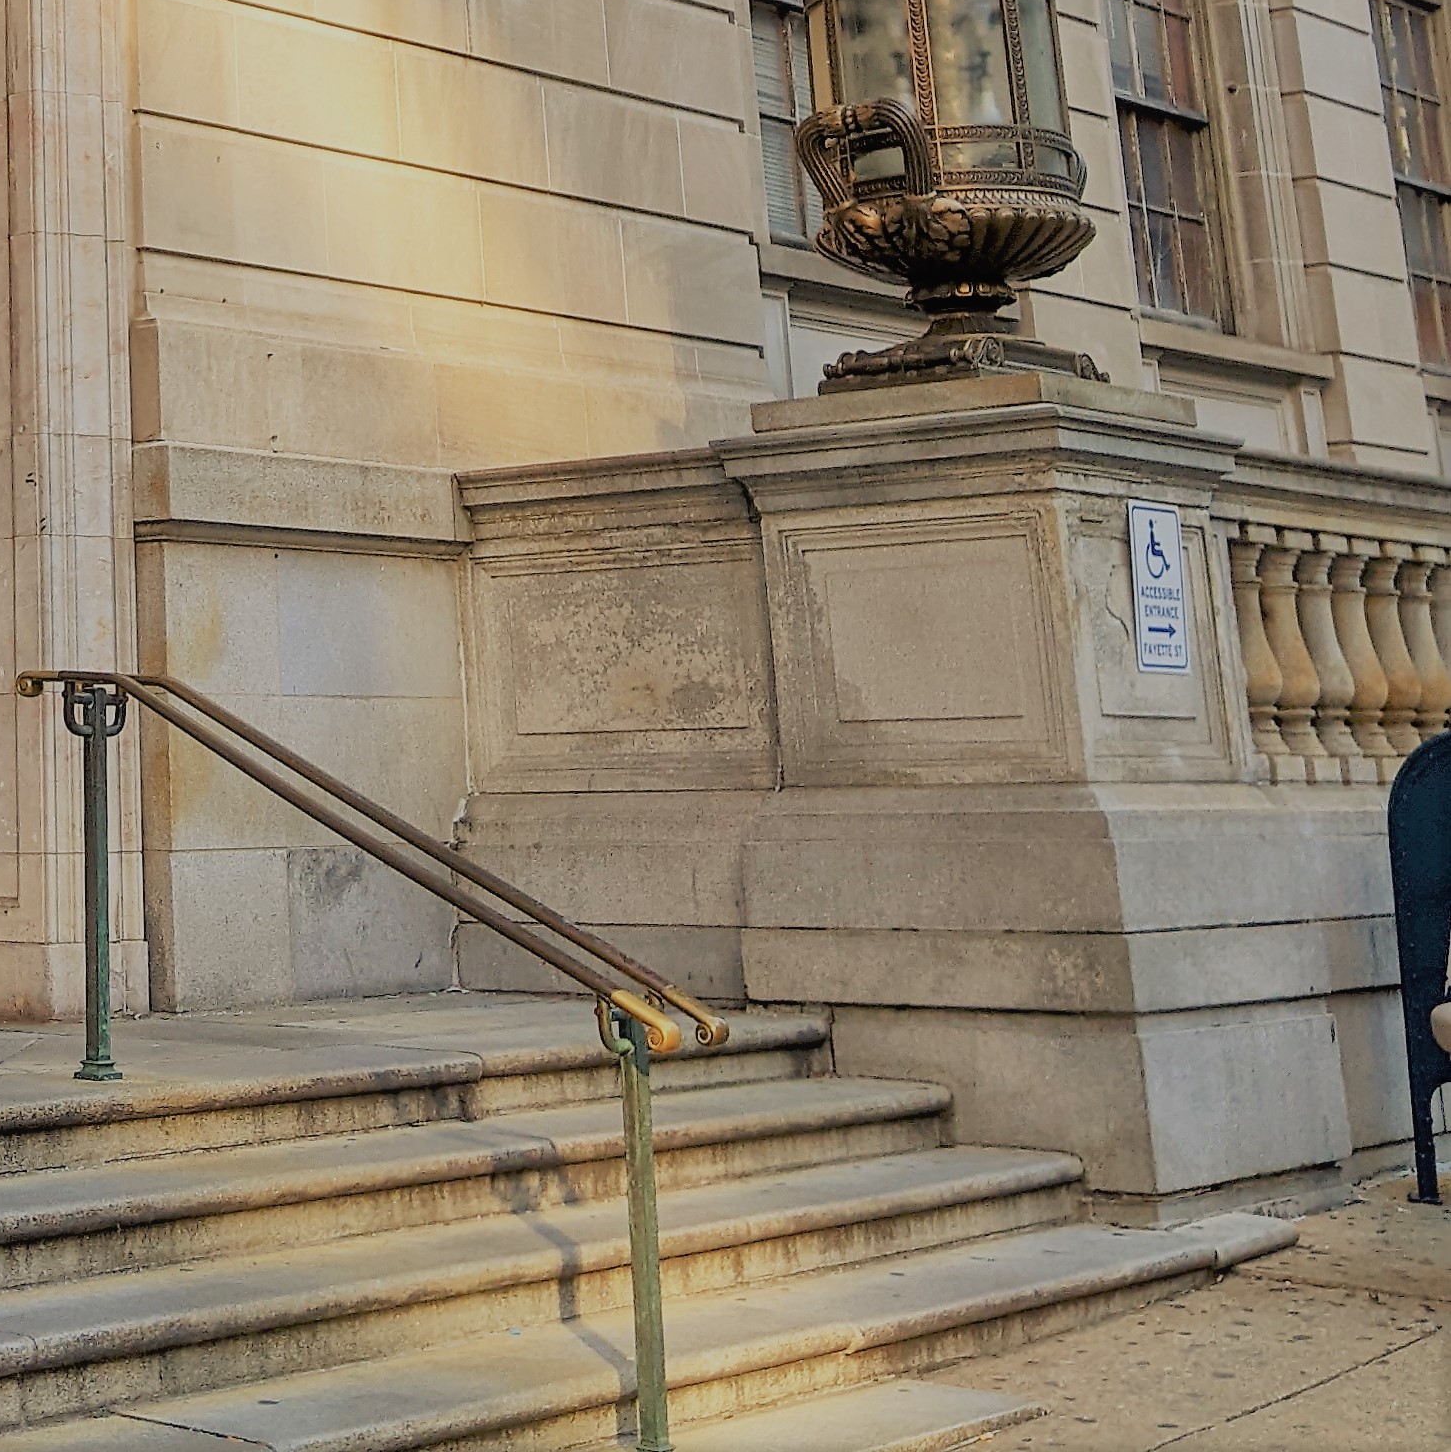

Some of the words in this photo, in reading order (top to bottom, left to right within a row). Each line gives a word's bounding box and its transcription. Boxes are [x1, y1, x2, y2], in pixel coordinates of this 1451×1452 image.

[1140, 585, 1180, 601] ACCESSIBLE
[1144, 604, 1179, 620] ENTRANCE
[1143, 642, 1172, 658] FAYETTE
